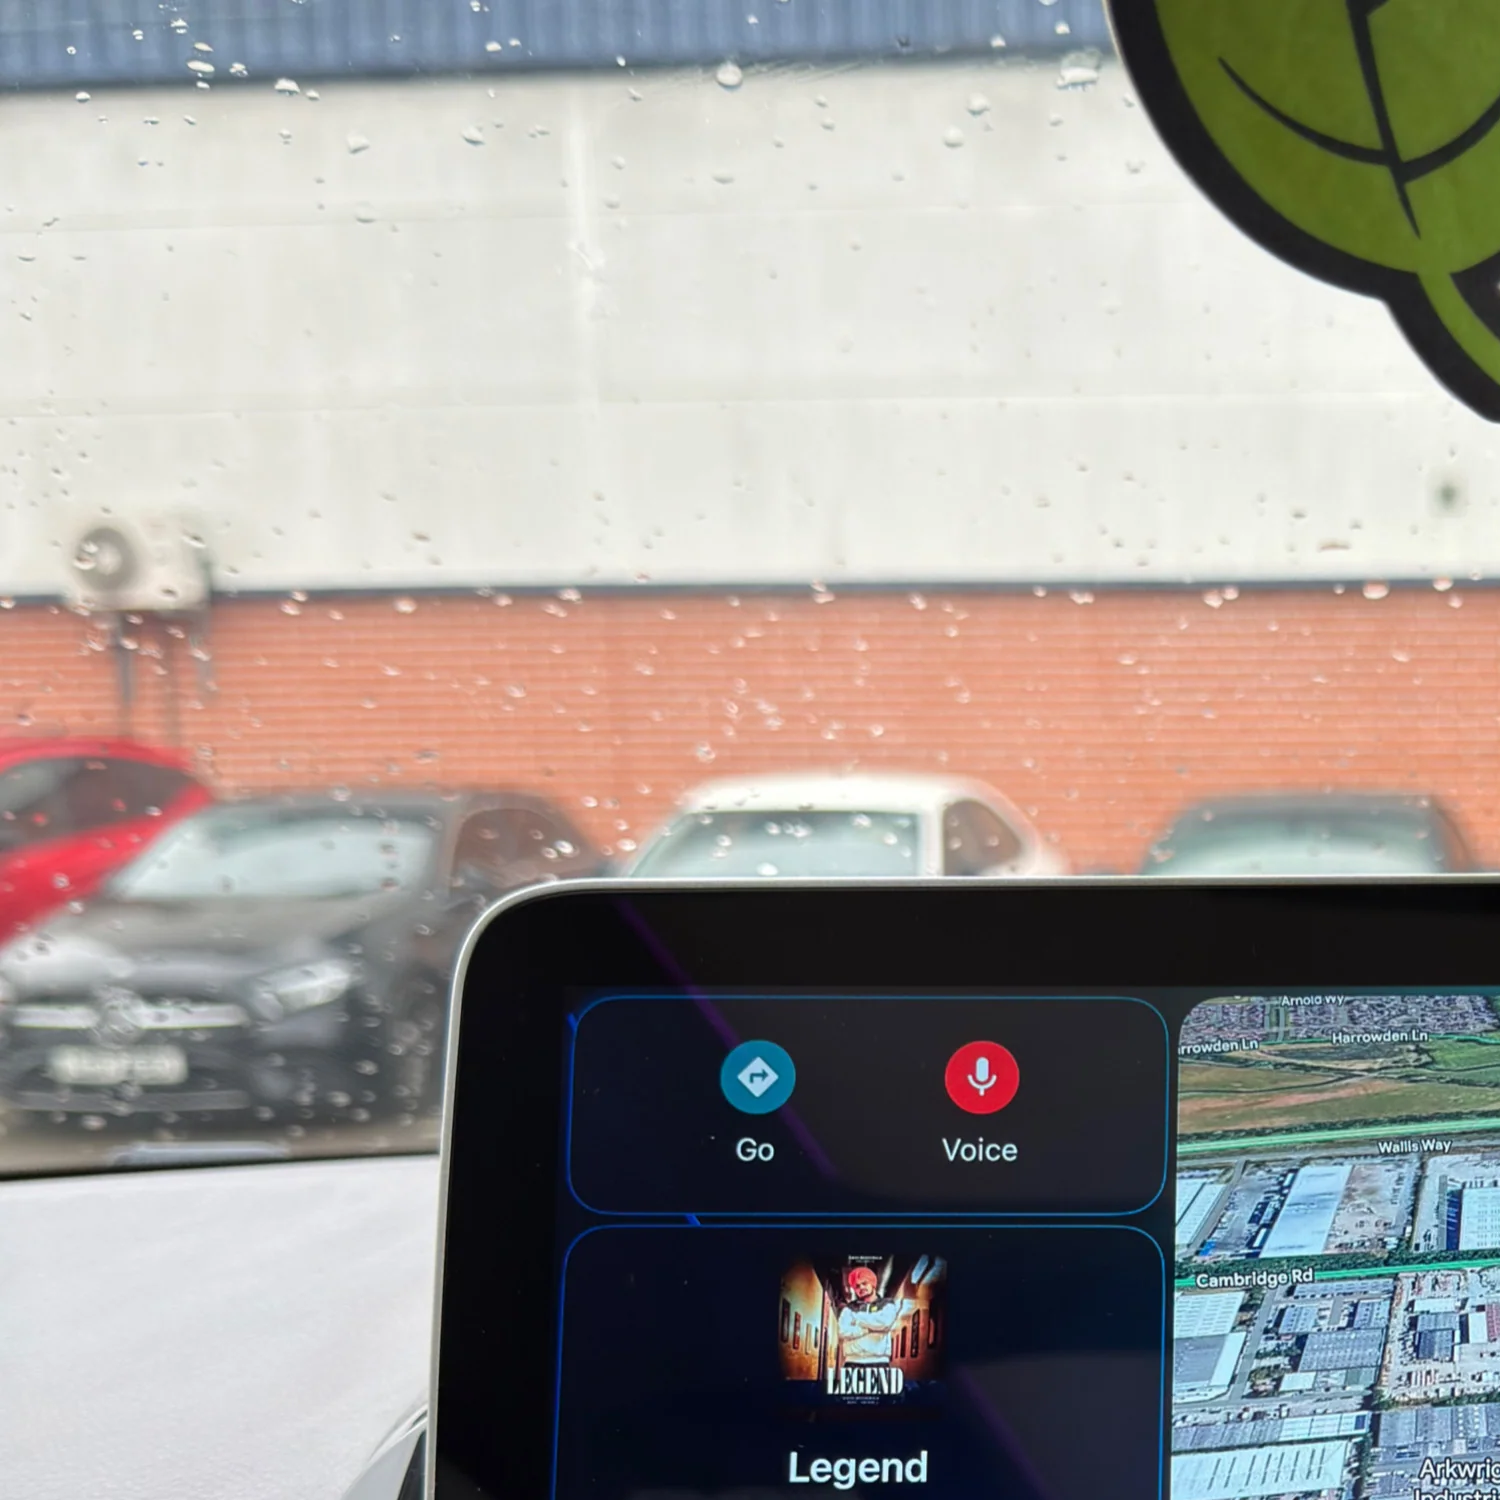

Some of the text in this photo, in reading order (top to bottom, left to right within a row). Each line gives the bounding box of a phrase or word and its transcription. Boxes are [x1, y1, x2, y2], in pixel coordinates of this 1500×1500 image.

[1241, 1038, 1259, 1050] Ln
[1332, 1031, 1429, 1045] Harrowden Ln
[736, 1138, 775, 1162] Go
[942, 1137, 1019, 1163] Voice
[1377, 1138, 1452, 1155] Wallis Way
[1196, 1268, 1314, 1290] Cambridge Rd
[827, 1366, 904, 1395] LEGEND
[788, 1450, 929, 1490] Legend
